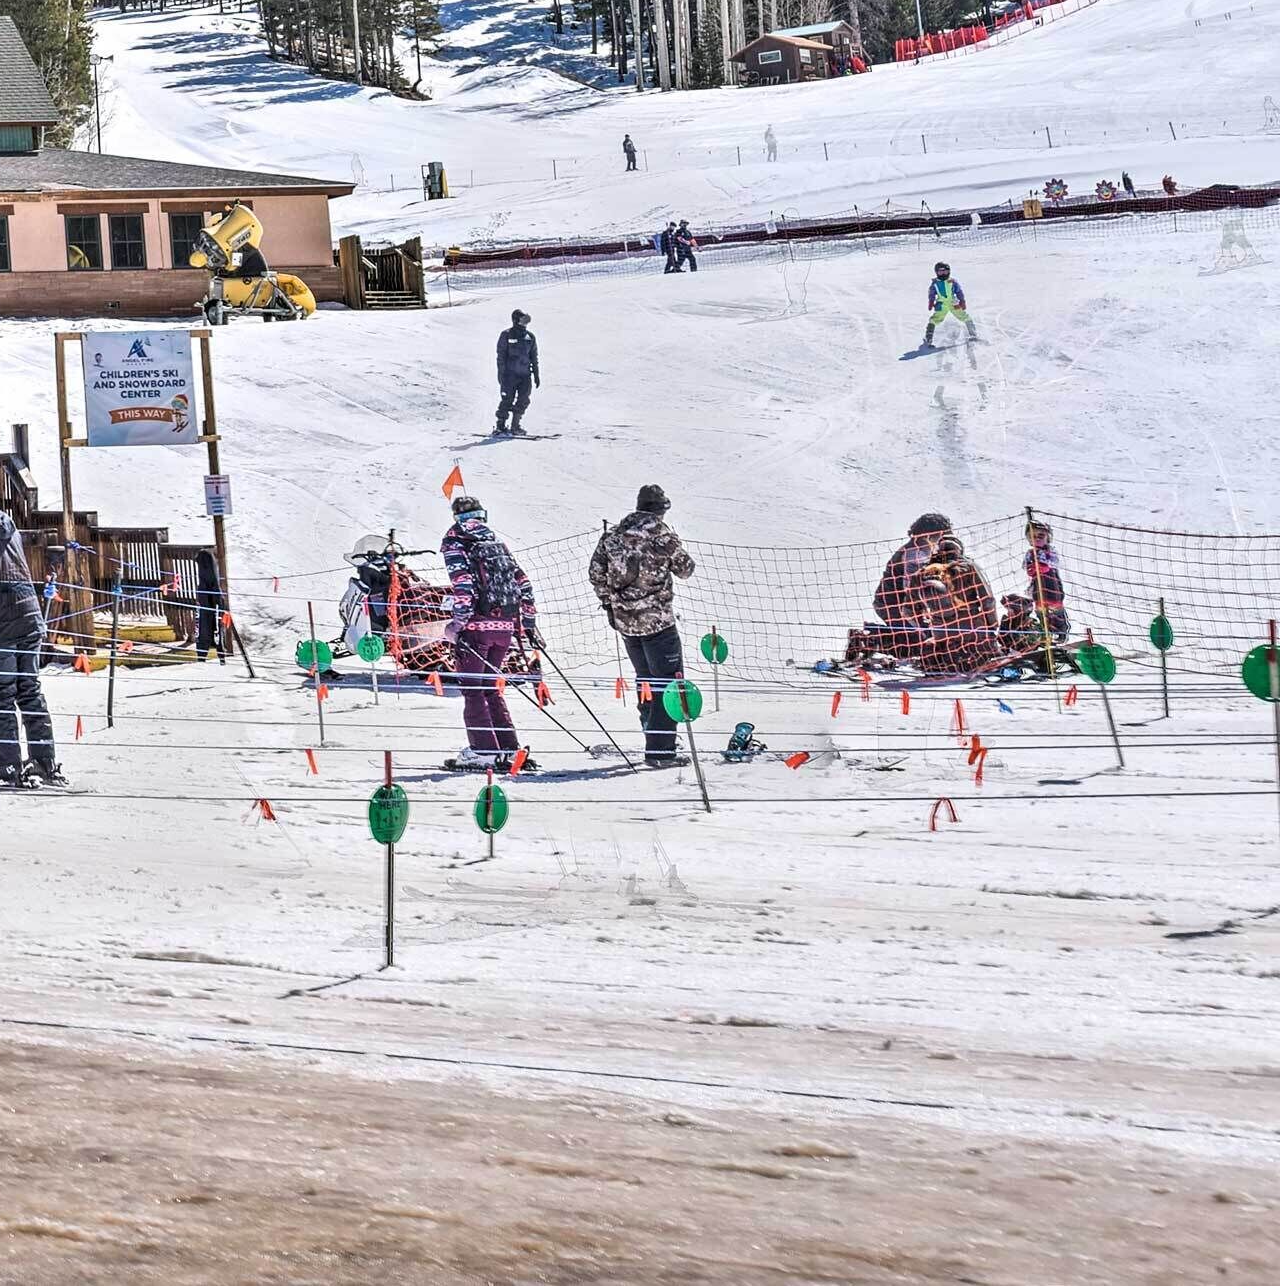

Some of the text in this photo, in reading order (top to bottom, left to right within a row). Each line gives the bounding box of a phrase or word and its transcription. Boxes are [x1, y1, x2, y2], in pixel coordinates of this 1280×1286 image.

[99, 369, 178, 379] CHILDREN'S SKI
[93, 379, 186, 389] AND SNOWBOARD
[120, 389, 161, 399] CENTER
[118, 409, 167, 420] THIS WAY
